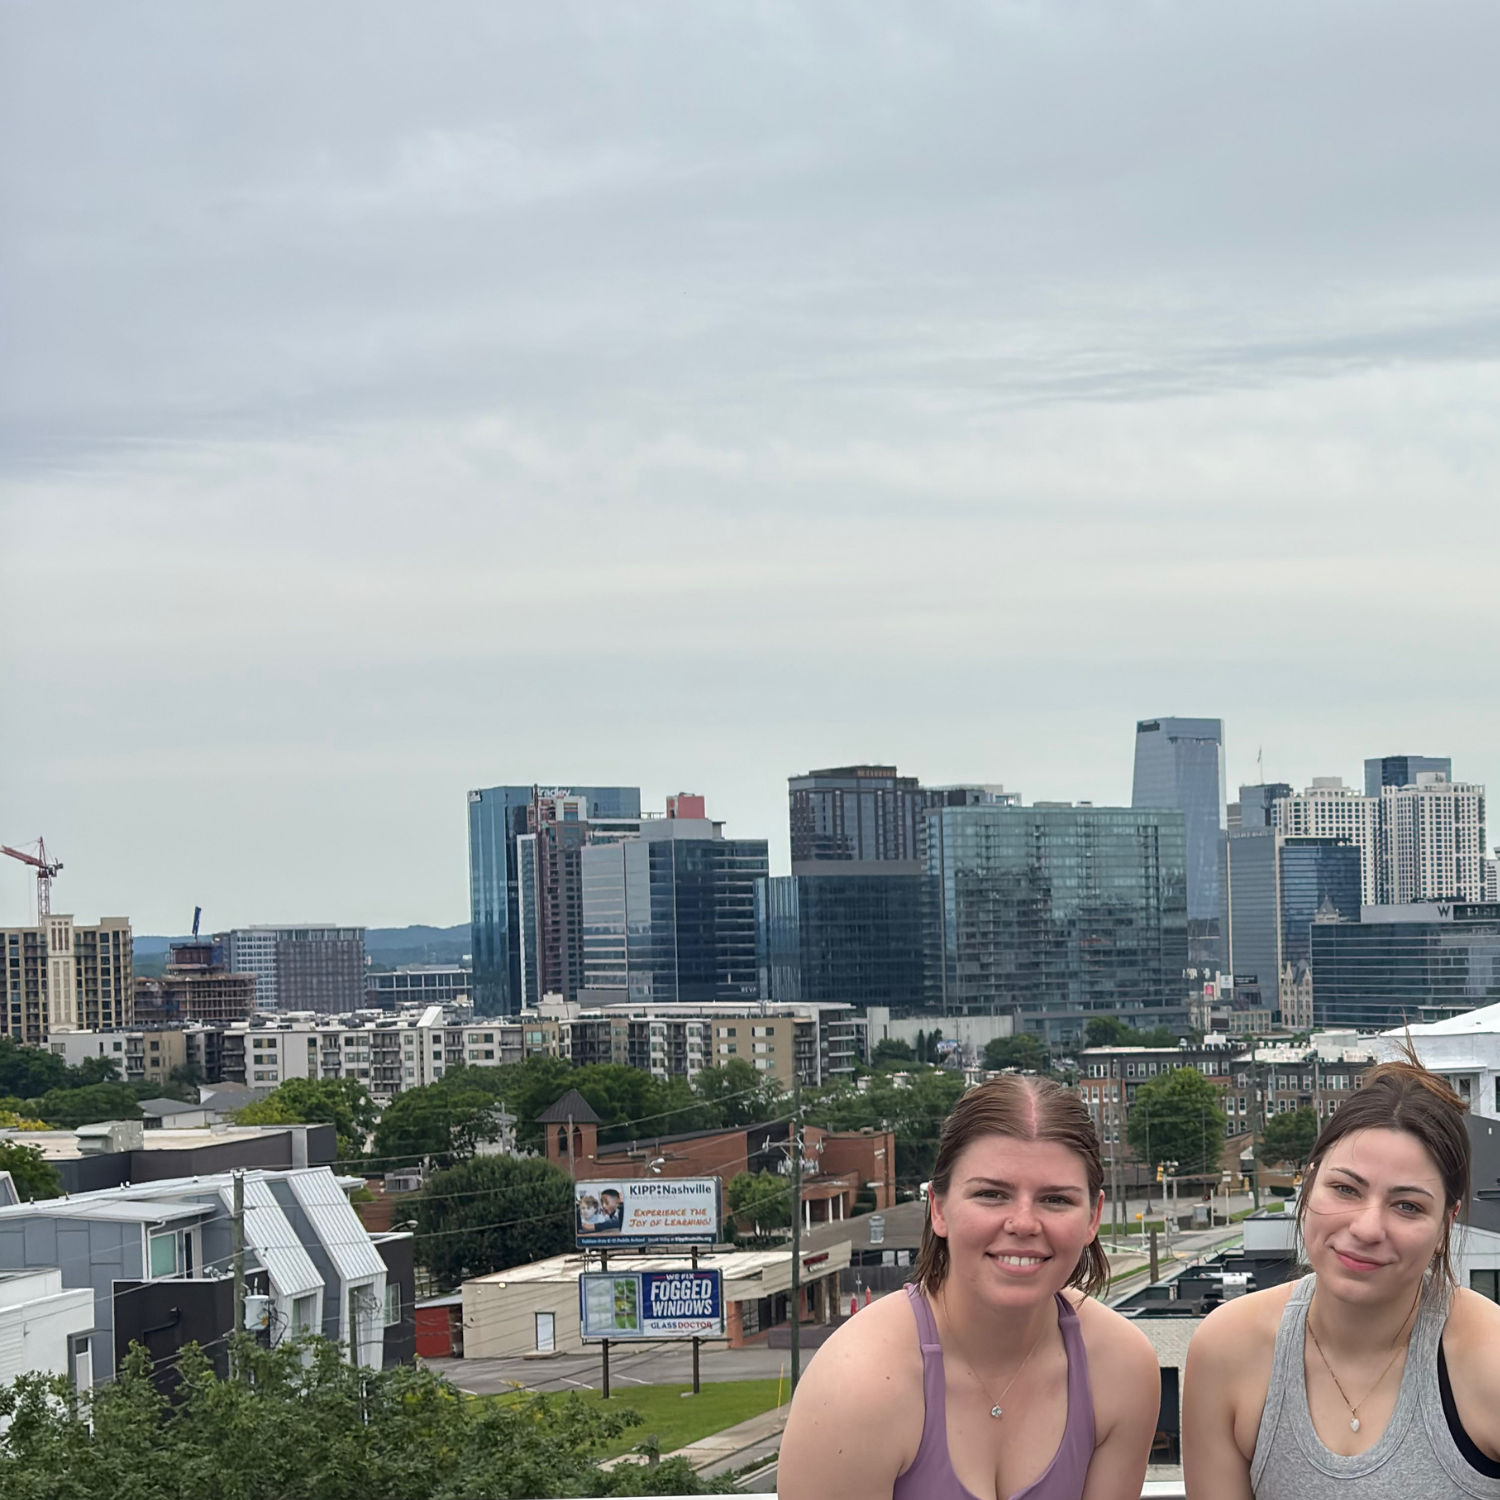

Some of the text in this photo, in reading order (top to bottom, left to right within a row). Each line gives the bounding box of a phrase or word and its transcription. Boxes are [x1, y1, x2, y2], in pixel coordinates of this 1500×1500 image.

[1437, 905, 1450, 917] W
[690, 1207, 707, 1216] THE
[650, 1219, 661, 1228] OF
[651, 1279, 712, 1300] FOGGED
[652, 1299, 712, 1317] WINDOWS
